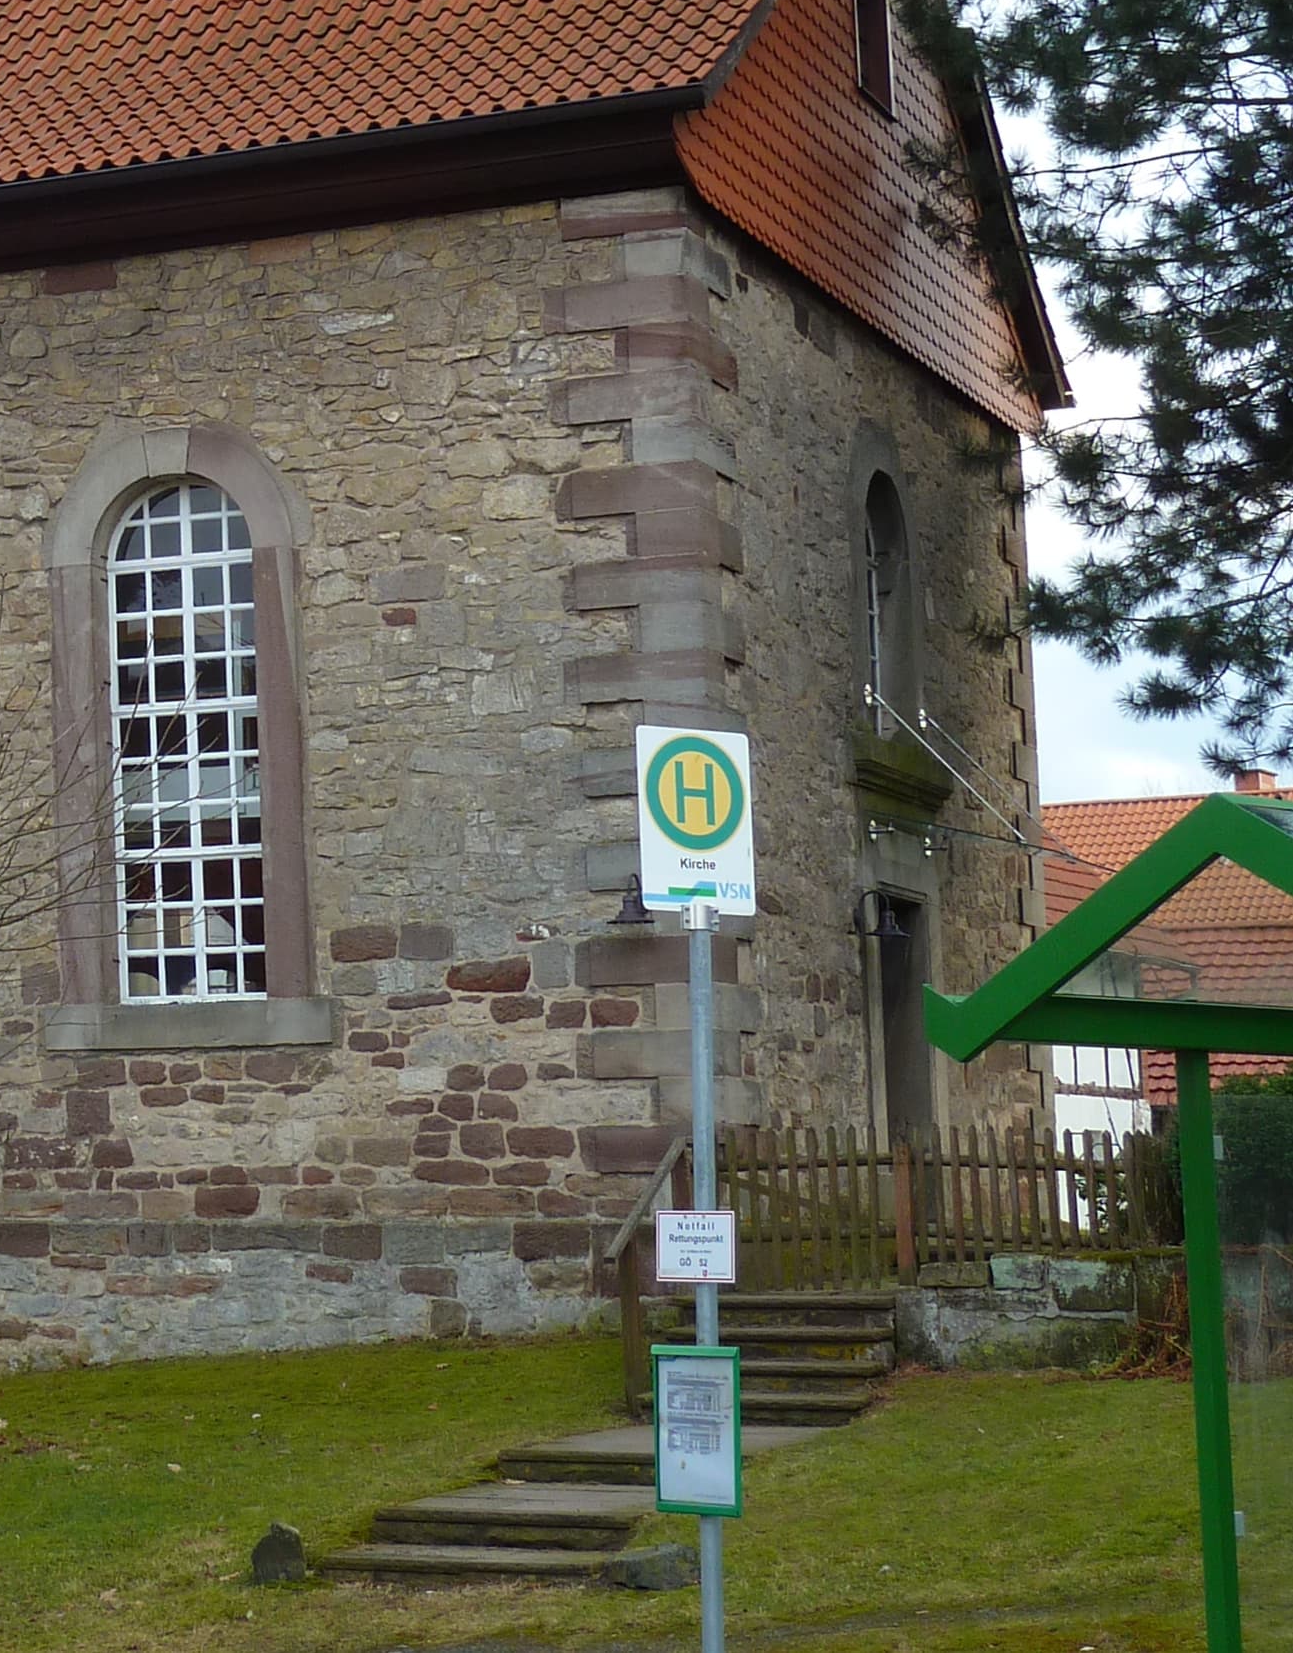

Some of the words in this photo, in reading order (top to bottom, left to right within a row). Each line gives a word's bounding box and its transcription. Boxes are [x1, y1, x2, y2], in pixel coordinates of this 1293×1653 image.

[674, 761, 716, 826] H
[680, 858, 716, 870] Kirche
[719, 882, 751, 899] VSN
[677, 1222, 715, 1230] Notfall
[669, 1234, 724, 1245] Rettungspunkt
